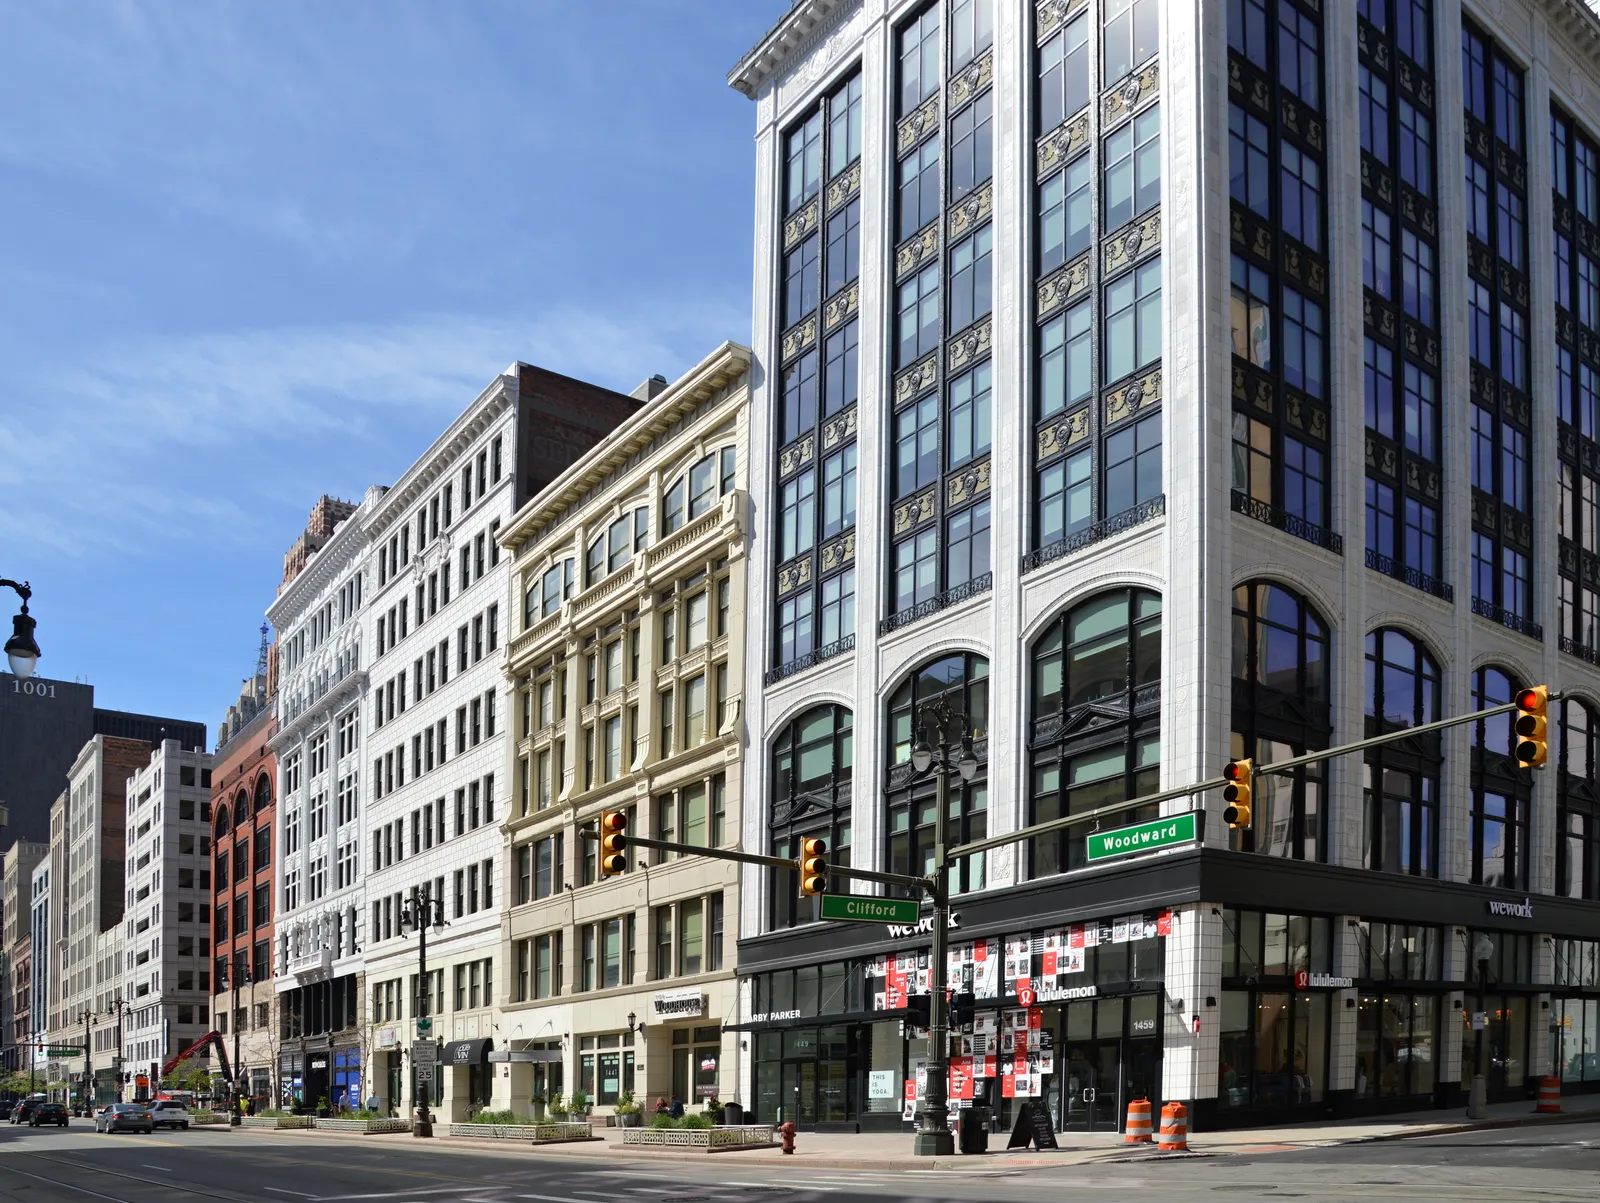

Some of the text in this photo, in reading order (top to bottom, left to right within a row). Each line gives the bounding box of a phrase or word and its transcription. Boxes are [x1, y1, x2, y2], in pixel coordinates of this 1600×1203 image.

[12, 680, 56, 698] 1001
[1104, 824, 1176, 850] Woodward
[847, 902, 896, 916] Clifford
[1489, 898, 1533, 919] wework
[1309, 973, 1353, 987] lululemon
[1036, 985, 1097, 1002] lululemon
[770, 1009, 801, 1021] PARKER
[1134, 1020, 1154, 1030] 1459
[418, 1071, 432, 1079] 25
